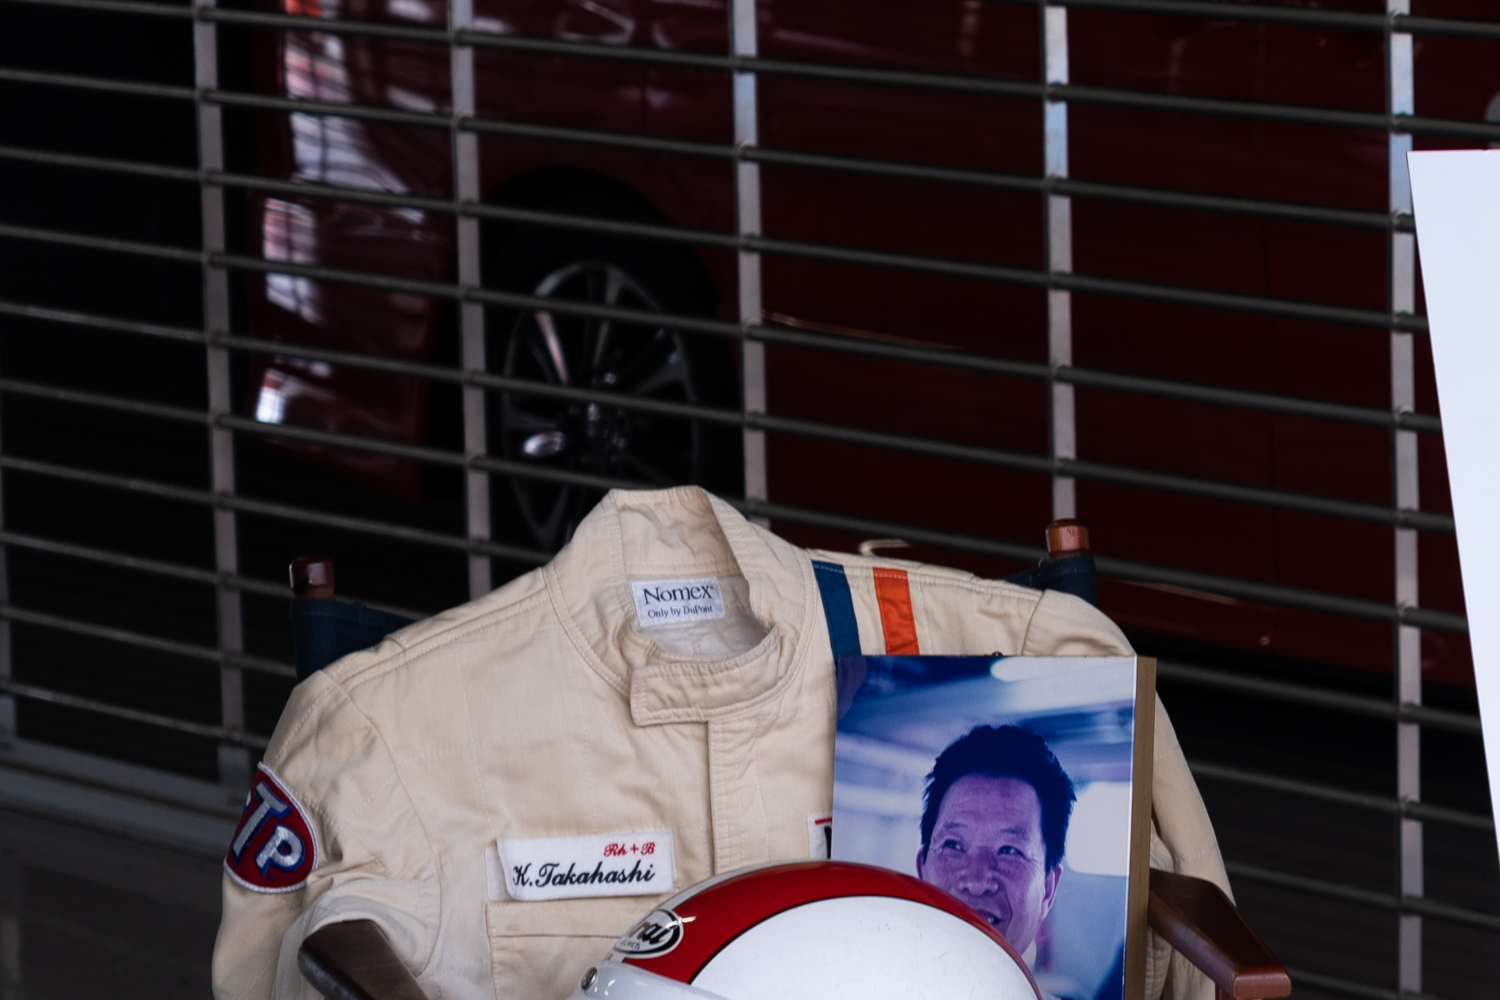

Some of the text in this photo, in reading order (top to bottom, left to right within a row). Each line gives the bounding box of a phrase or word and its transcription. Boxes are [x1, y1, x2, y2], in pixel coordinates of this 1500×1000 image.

[647, 604, 713, 619] Only by DuPont
[231, 780, 306, 878] TP
